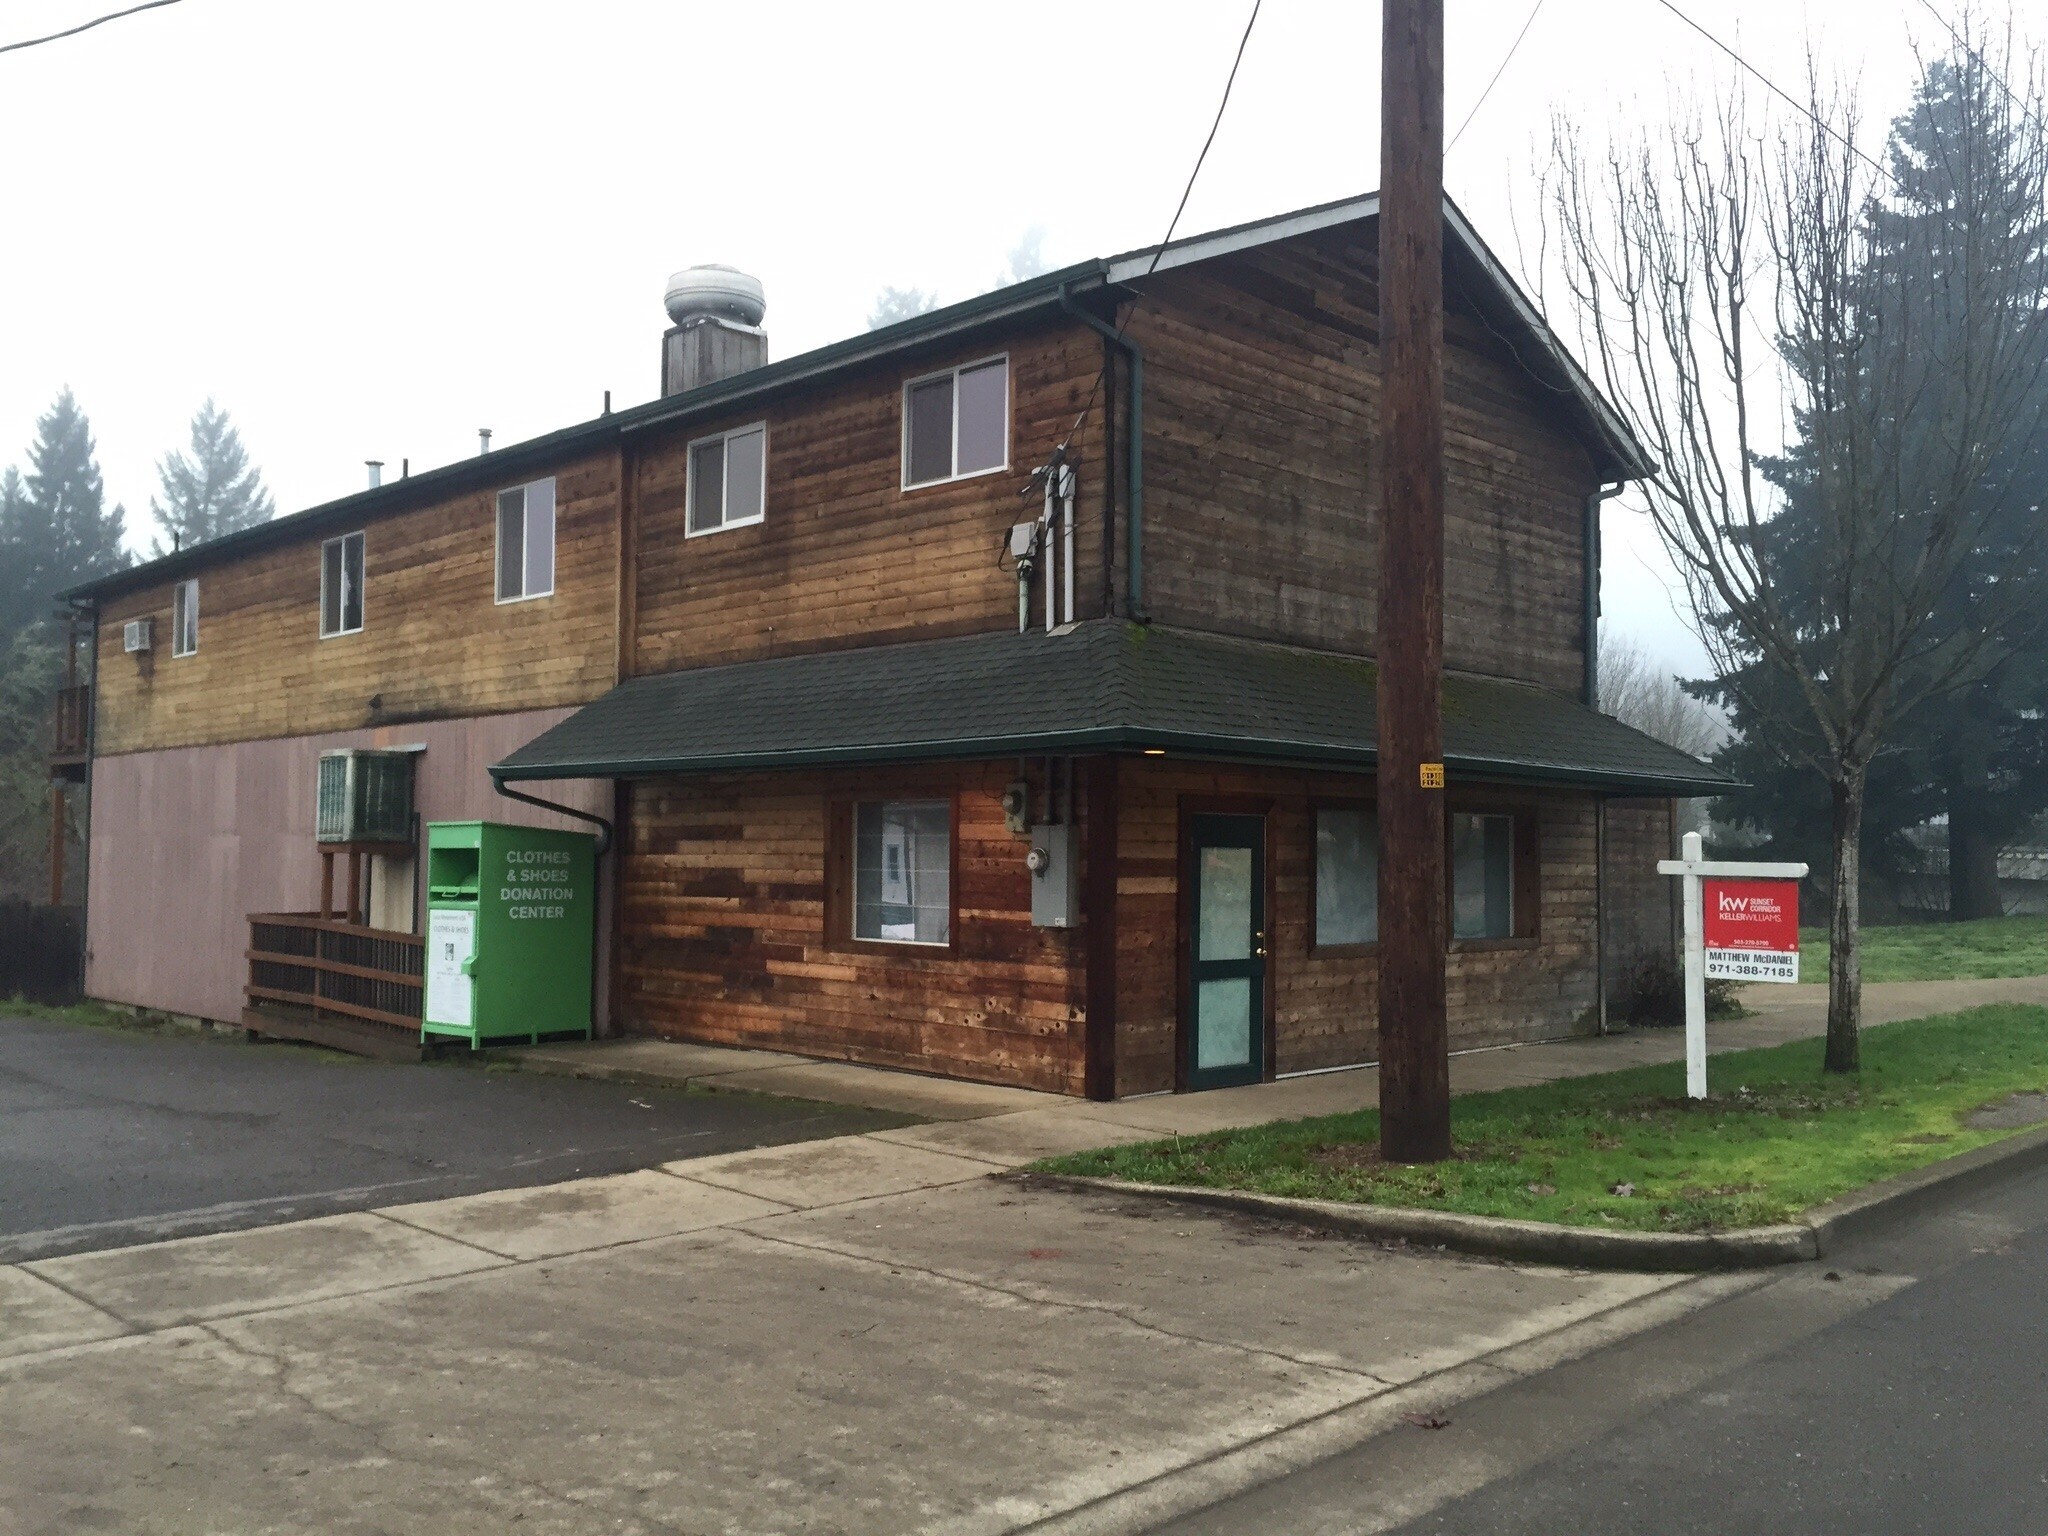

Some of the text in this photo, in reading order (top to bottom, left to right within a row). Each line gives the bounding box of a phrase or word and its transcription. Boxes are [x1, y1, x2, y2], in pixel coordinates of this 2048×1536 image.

[507, 851, 571, 863] CLOTHES
[507, 869, 568, 882] & SHOES
[500, 888, 573, 900] DONATION
[1719, 891, 1749, 911] kw
[509, 906, 564, 919] CENTER
[1750, 905, 1781, 913] CORRIDOR
[1709, 951, 1793, 965] MATTHEW McDANIEL
[1709, 963, 1794, 977] 971-388-7185
